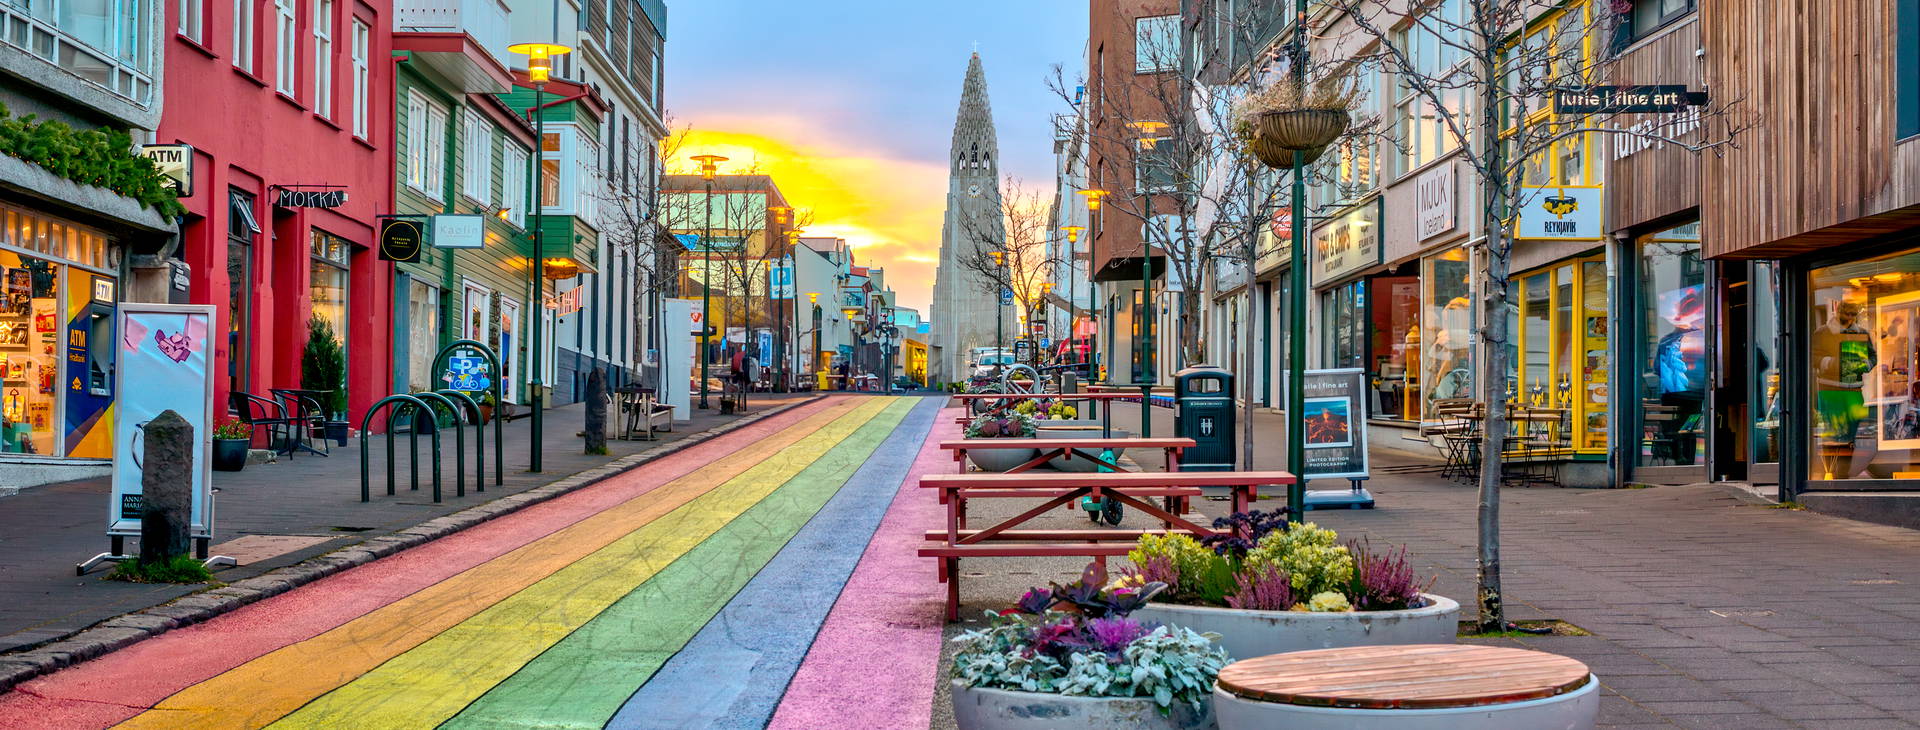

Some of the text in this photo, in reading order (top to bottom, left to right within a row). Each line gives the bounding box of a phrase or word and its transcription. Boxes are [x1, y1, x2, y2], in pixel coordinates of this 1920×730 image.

[1654, 92, 1678, 106] art
[149, 150, 182, 163] ATM
[280, 190, 341, 209] MOKKA
[1421, 170, 1447, 213] MJÚK
[1424, 209, 1445, 237] Iceland
[1544, 219, 1577, 235] REYKJAVÍK
[1335, 224, 1351, 255] CHIPS
[96, 282, 113, 301] ATM
[70, 329, 86, 347] ATM
[461, 360, 472, 374] P
